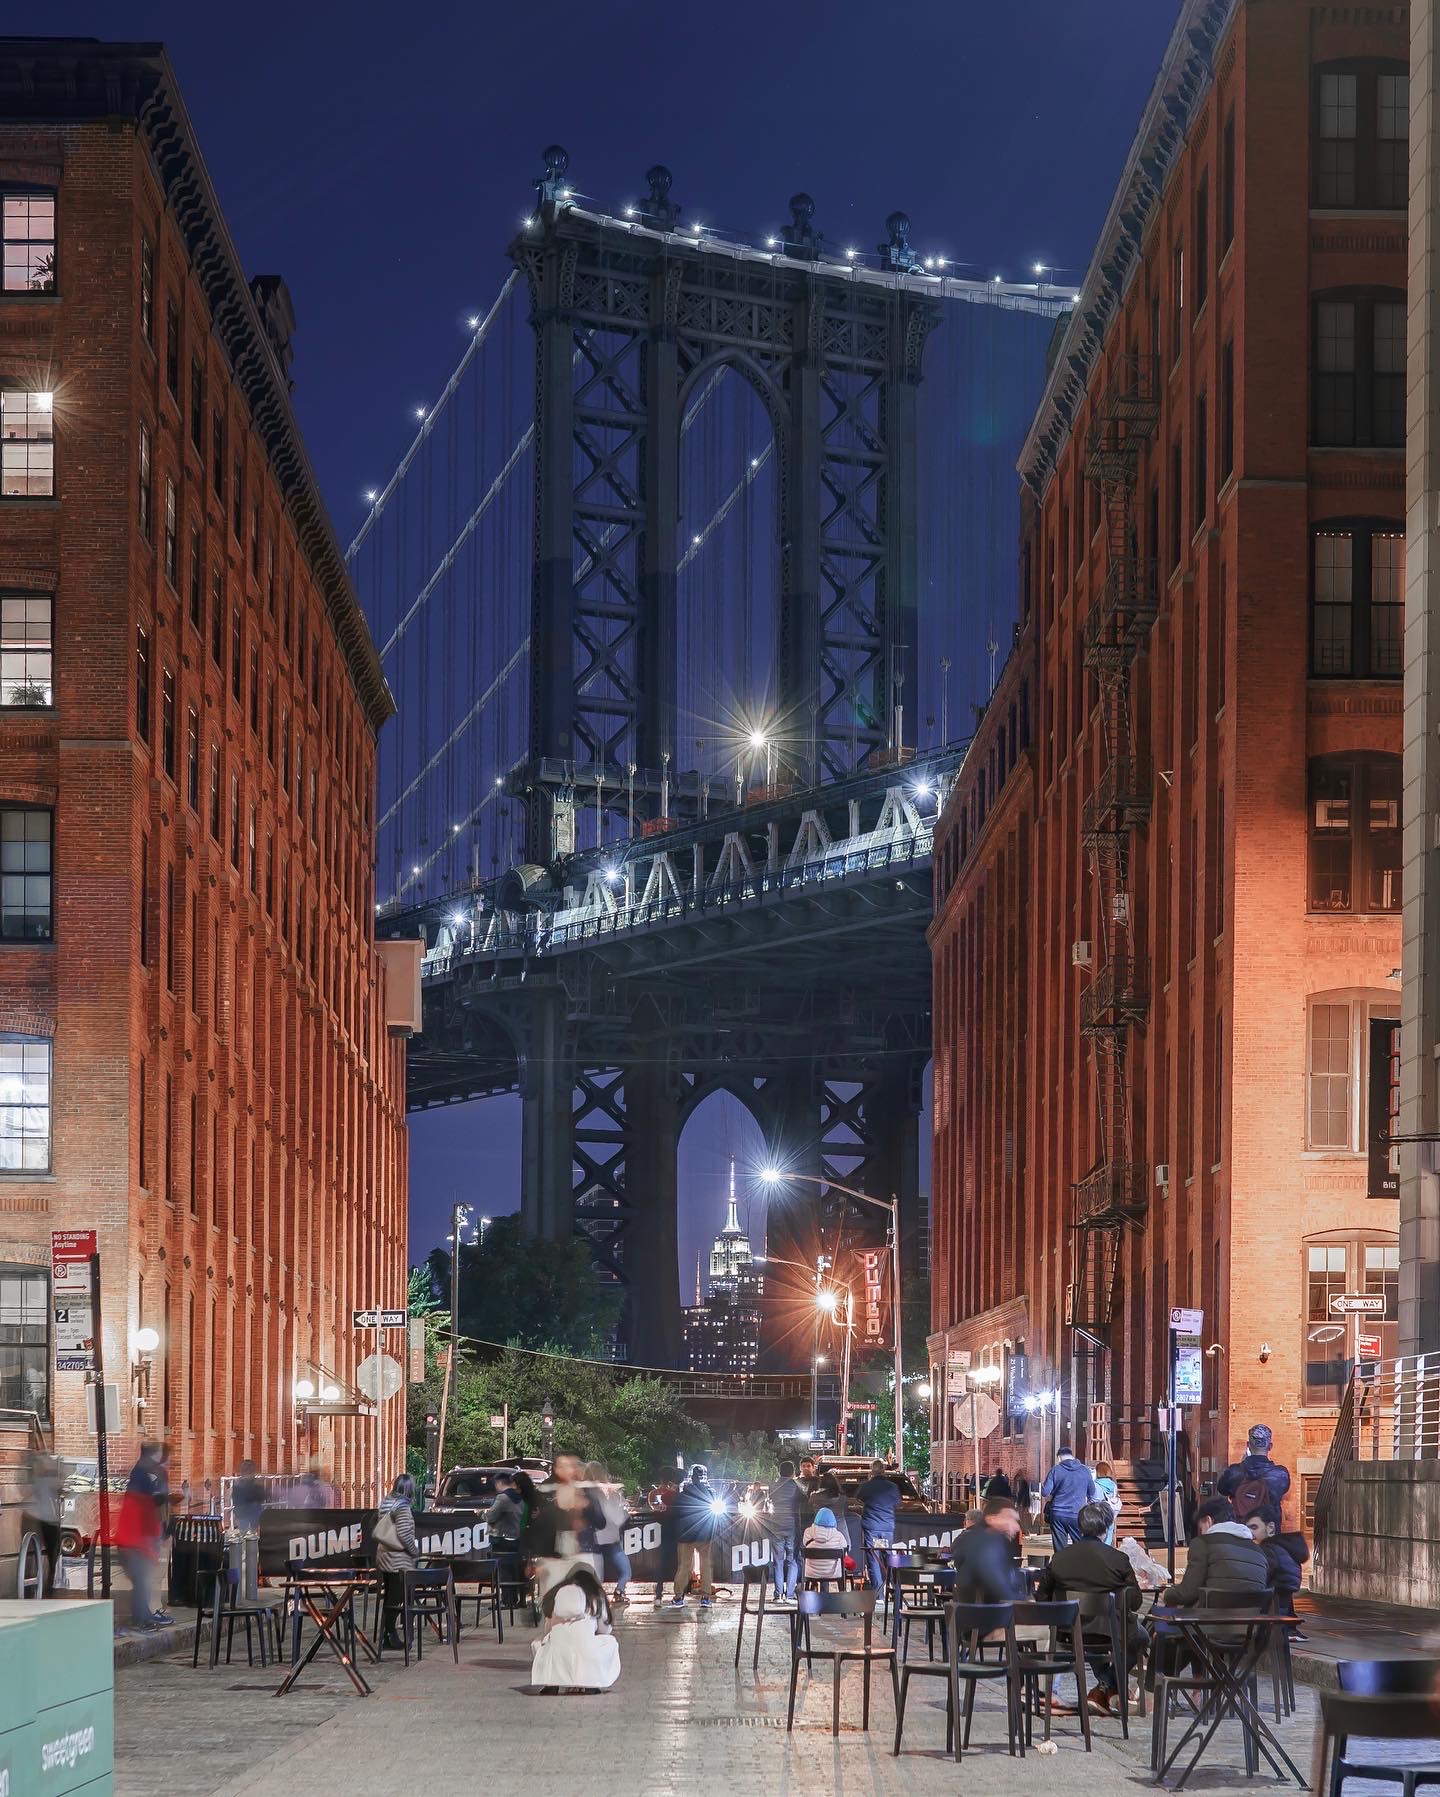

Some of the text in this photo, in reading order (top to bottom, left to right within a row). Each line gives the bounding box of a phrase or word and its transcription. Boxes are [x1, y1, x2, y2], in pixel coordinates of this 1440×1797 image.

[54, 1241, 77, 1249] Anytime
[864, 1252, 882, 1336] DUMBO
[1337, 1300, 1380, 1308] ONE WAY
[57, 1309, 66, 1322] 2
[361, 1315, 399, 1323] ONE WAY
